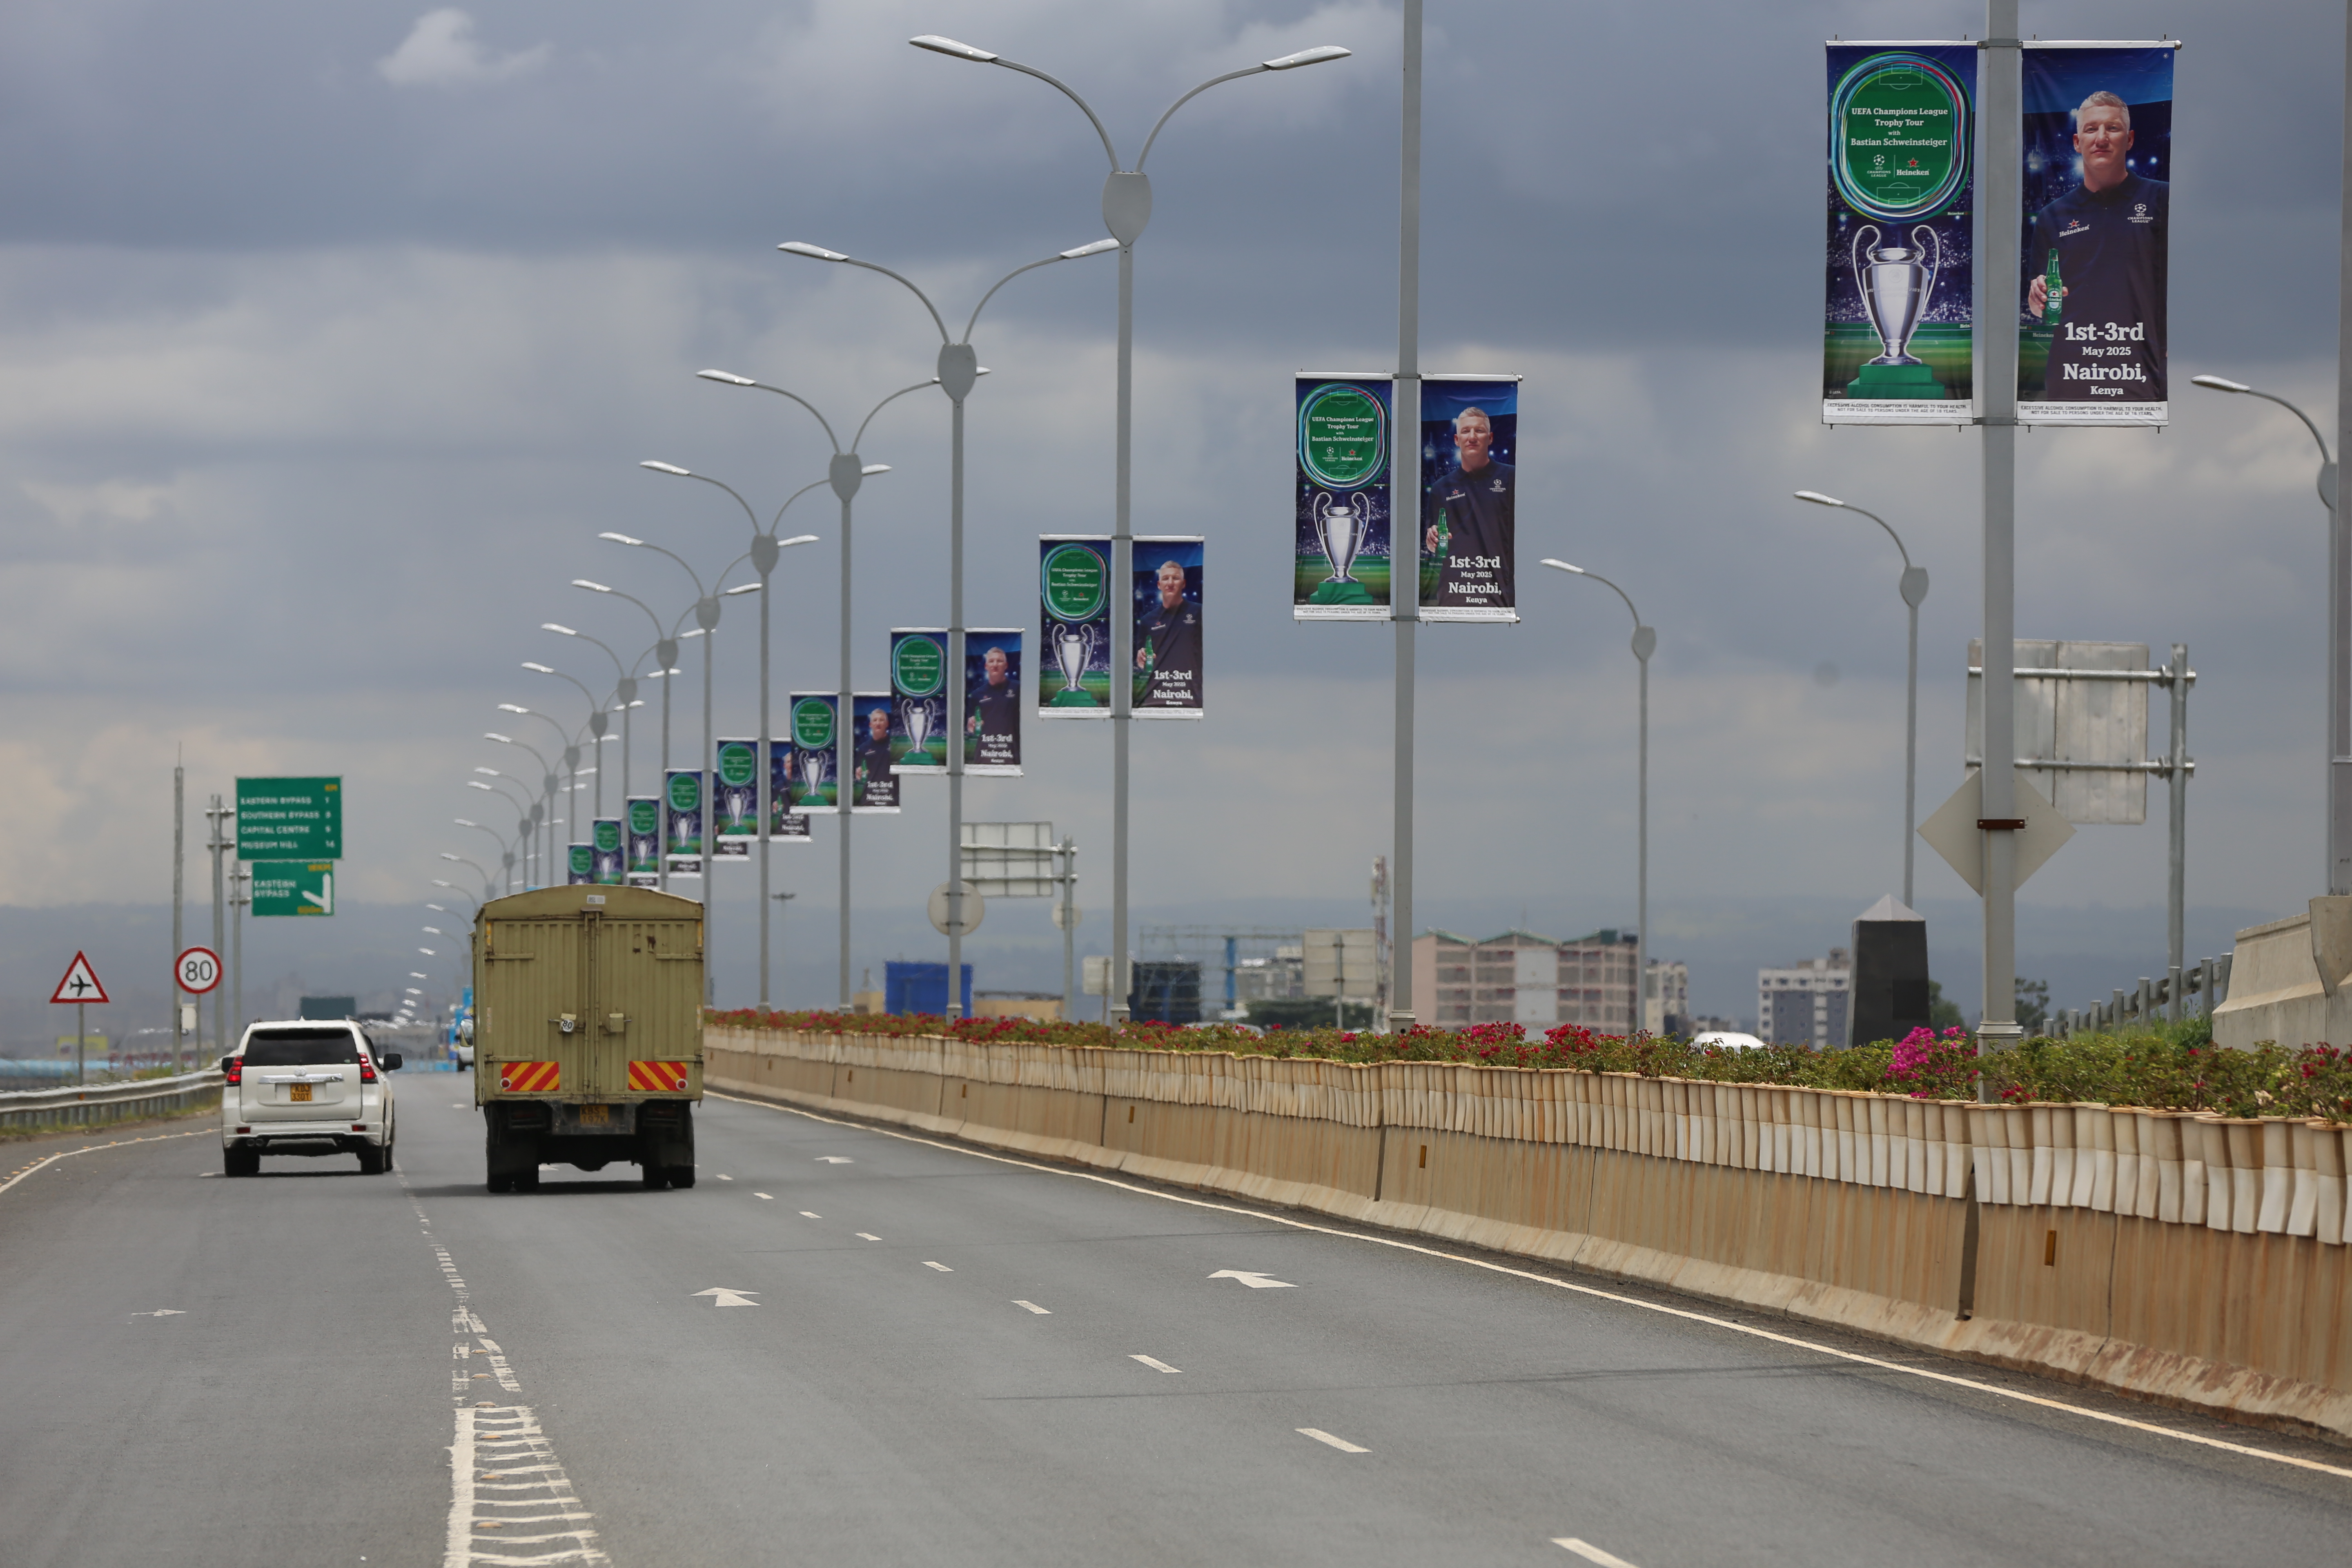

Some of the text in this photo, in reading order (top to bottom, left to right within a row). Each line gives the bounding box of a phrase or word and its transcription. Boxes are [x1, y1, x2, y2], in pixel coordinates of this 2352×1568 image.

[1873, 108, 1918, 116] Champions
[1919, 108, 1948, 116] League
[1875, 119, 1903, 127] Trophy
[1883, 138, 1947, 147] Schweinsteiger
[2059, 224, 2090, 238] Heineken
[2065, 322, 2145, 341] 1st-3rd
[2082, 347, 2132, 358] May 2025
[2063, 363, 2147, 383] Nairobi,
[2090, 385, 2124, 396] Kenya
[1450, 555, 1501, 568] 1st-3rd
[1448, 582, 1502, 595] Nairobi,
[1466, 596, 1488, 604] Kenya
[1154, 670, 1193, 680] 1st-3rd
[1153, 689, 1194, 700] Nairobi,
[241, 797, 278, 805] EASTERN
[280, 796, 312, 804] BYPASS
[241, 811, 287, 820] SOUTHERN
[288, 811, 320, 819] BYPASS
[241, 826, 275, 834] CAPITAL
[276, 825, 310, 834] CENTRE
[241, 841, 278, 849] MUSEUM
[254, 879, 296, 889] EASTERN
[254, 889, 290, 898] BYPASS
[186, 960, 212, 982] 80
[563, 1020, 572, 1029] 80
